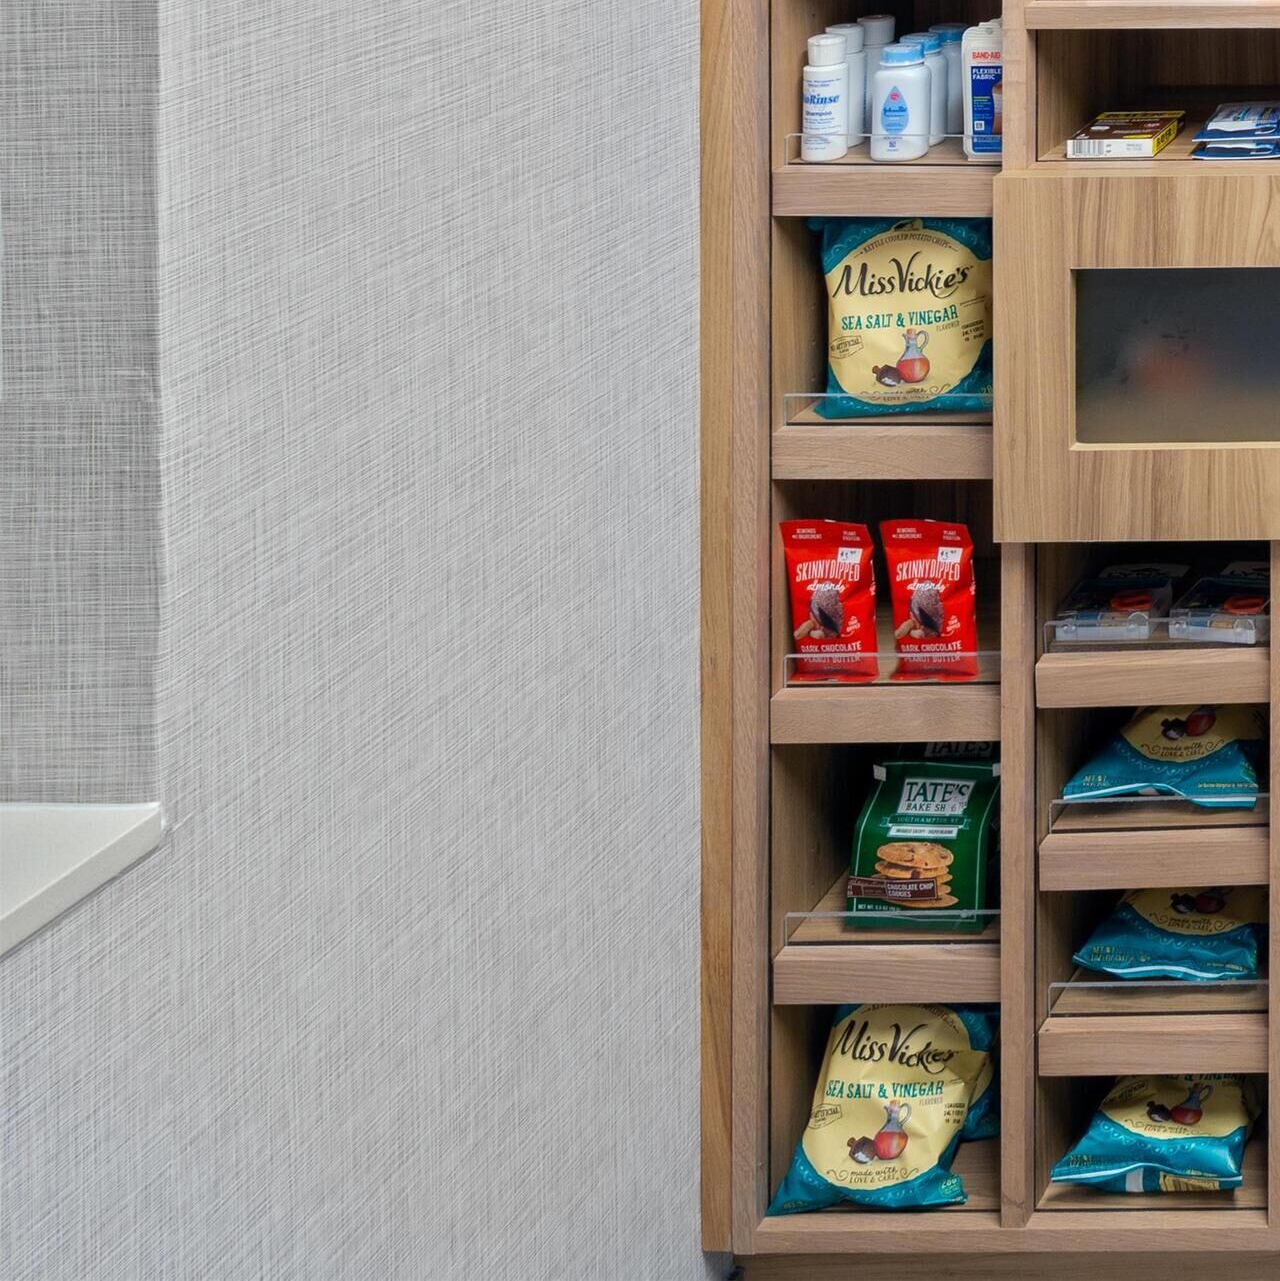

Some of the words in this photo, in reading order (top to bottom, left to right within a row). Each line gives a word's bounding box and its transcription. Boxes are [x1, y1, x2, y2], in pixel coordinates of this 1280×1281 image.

[832, 262, 896, 298] Miss
[889, 251, 973, 299] Vickie's
[841, 316, 862, 331] SEA
[866, 313, 893, 329] SALT
[896, 313, 905, 328] &
[908, 304, 959, 325] VINEGAR
[795, 559, 860, 582] SKINNYDIPPED
[896, 558, 960, 582] SKINNYDIPPED
[800, 645, 820, 653] DARK
[821, 640, 862, 652] CHOCOLATE
[900, 645, 920, 653] DARK
[921, 640, 962, 652] CHOCOLATE
[825, 1080, 844, 1098] SEA
[846, 1082, 874, 1099] SALT
[878, 1083, 888, 1099] &
[891, 1080, 944, 1098] VINEGAR
